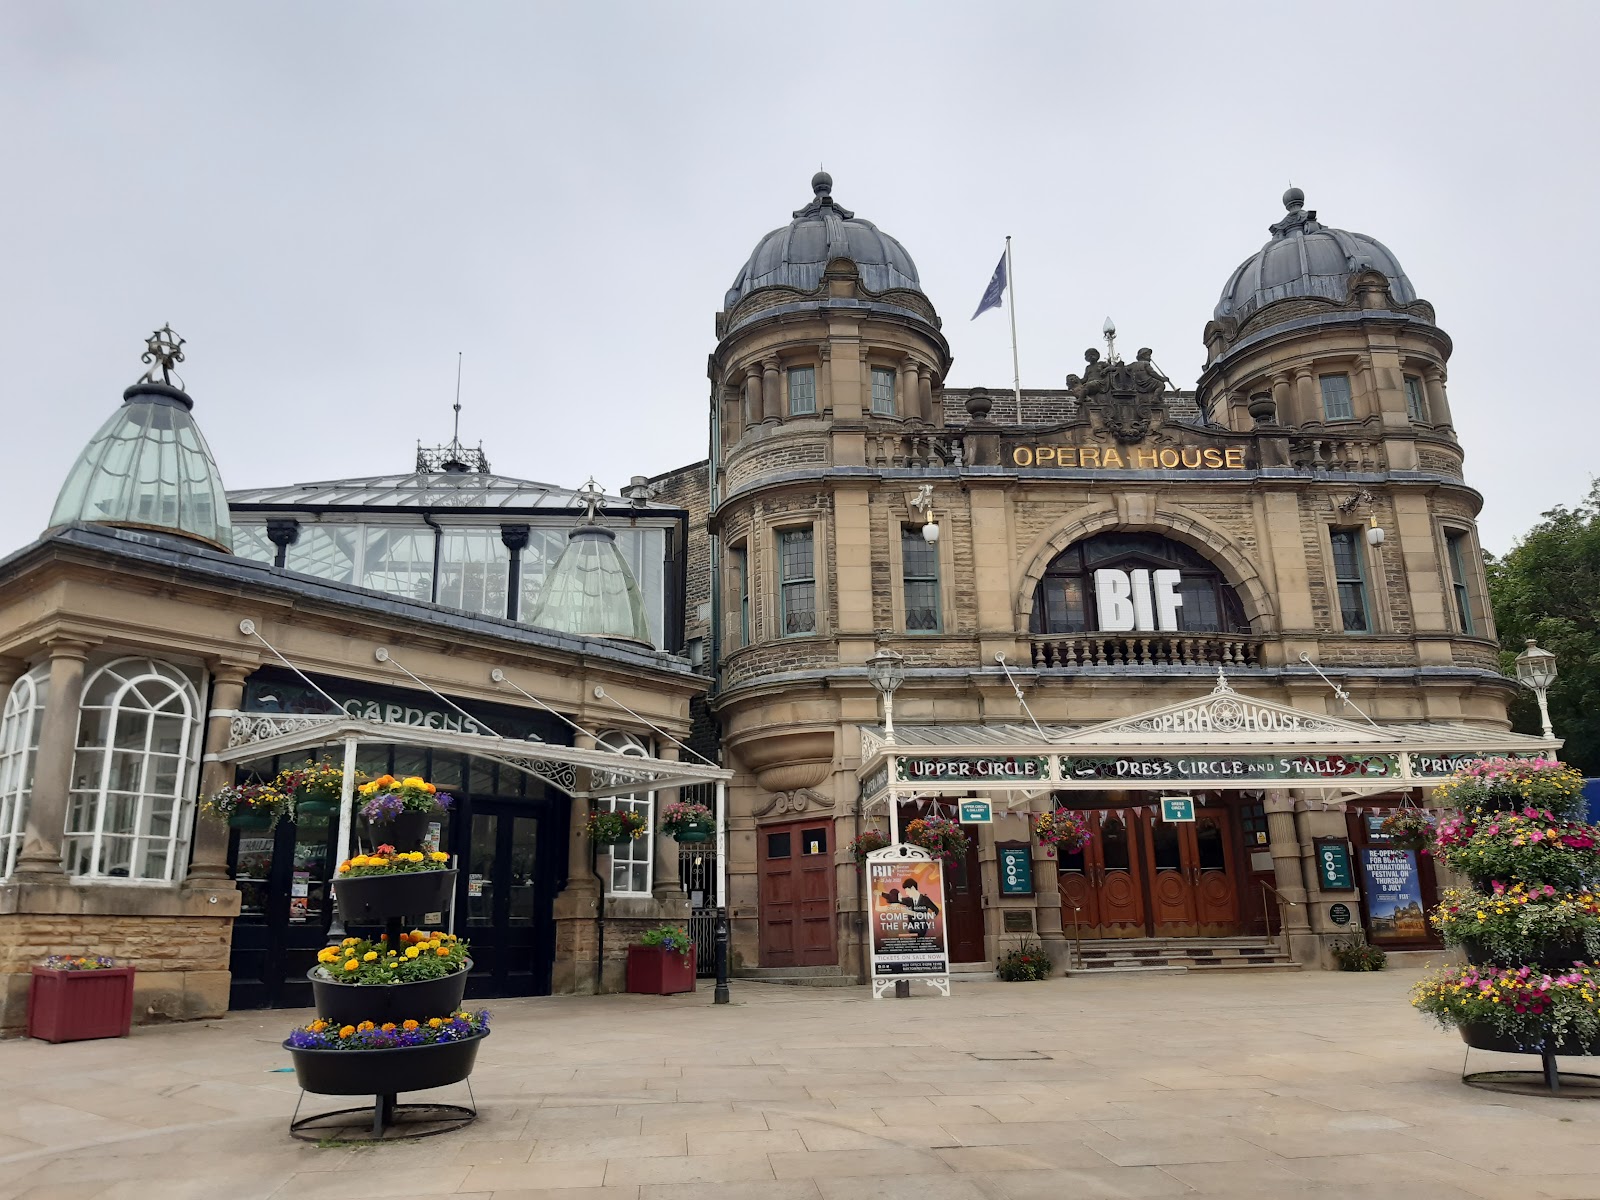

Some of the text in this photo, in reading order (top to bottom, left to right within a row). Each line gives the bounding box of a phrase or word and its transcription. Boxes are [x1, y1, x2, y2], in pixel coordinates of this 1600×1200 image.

[1012, 446, 1246, 468] OPERA HOUSE
[1094, 569, 1183, 631] BIF
[343, 699, 479, 734] GARDENS
[1153, 703, 1300, 732] OPERA HOUSE
[914, 760, 1035, 776] UPPER CIRCLE
[1116, 758, 1347, 776] DRESS CIRCLE AND STALLS
[902, 922, 935, 930] PARTY!
